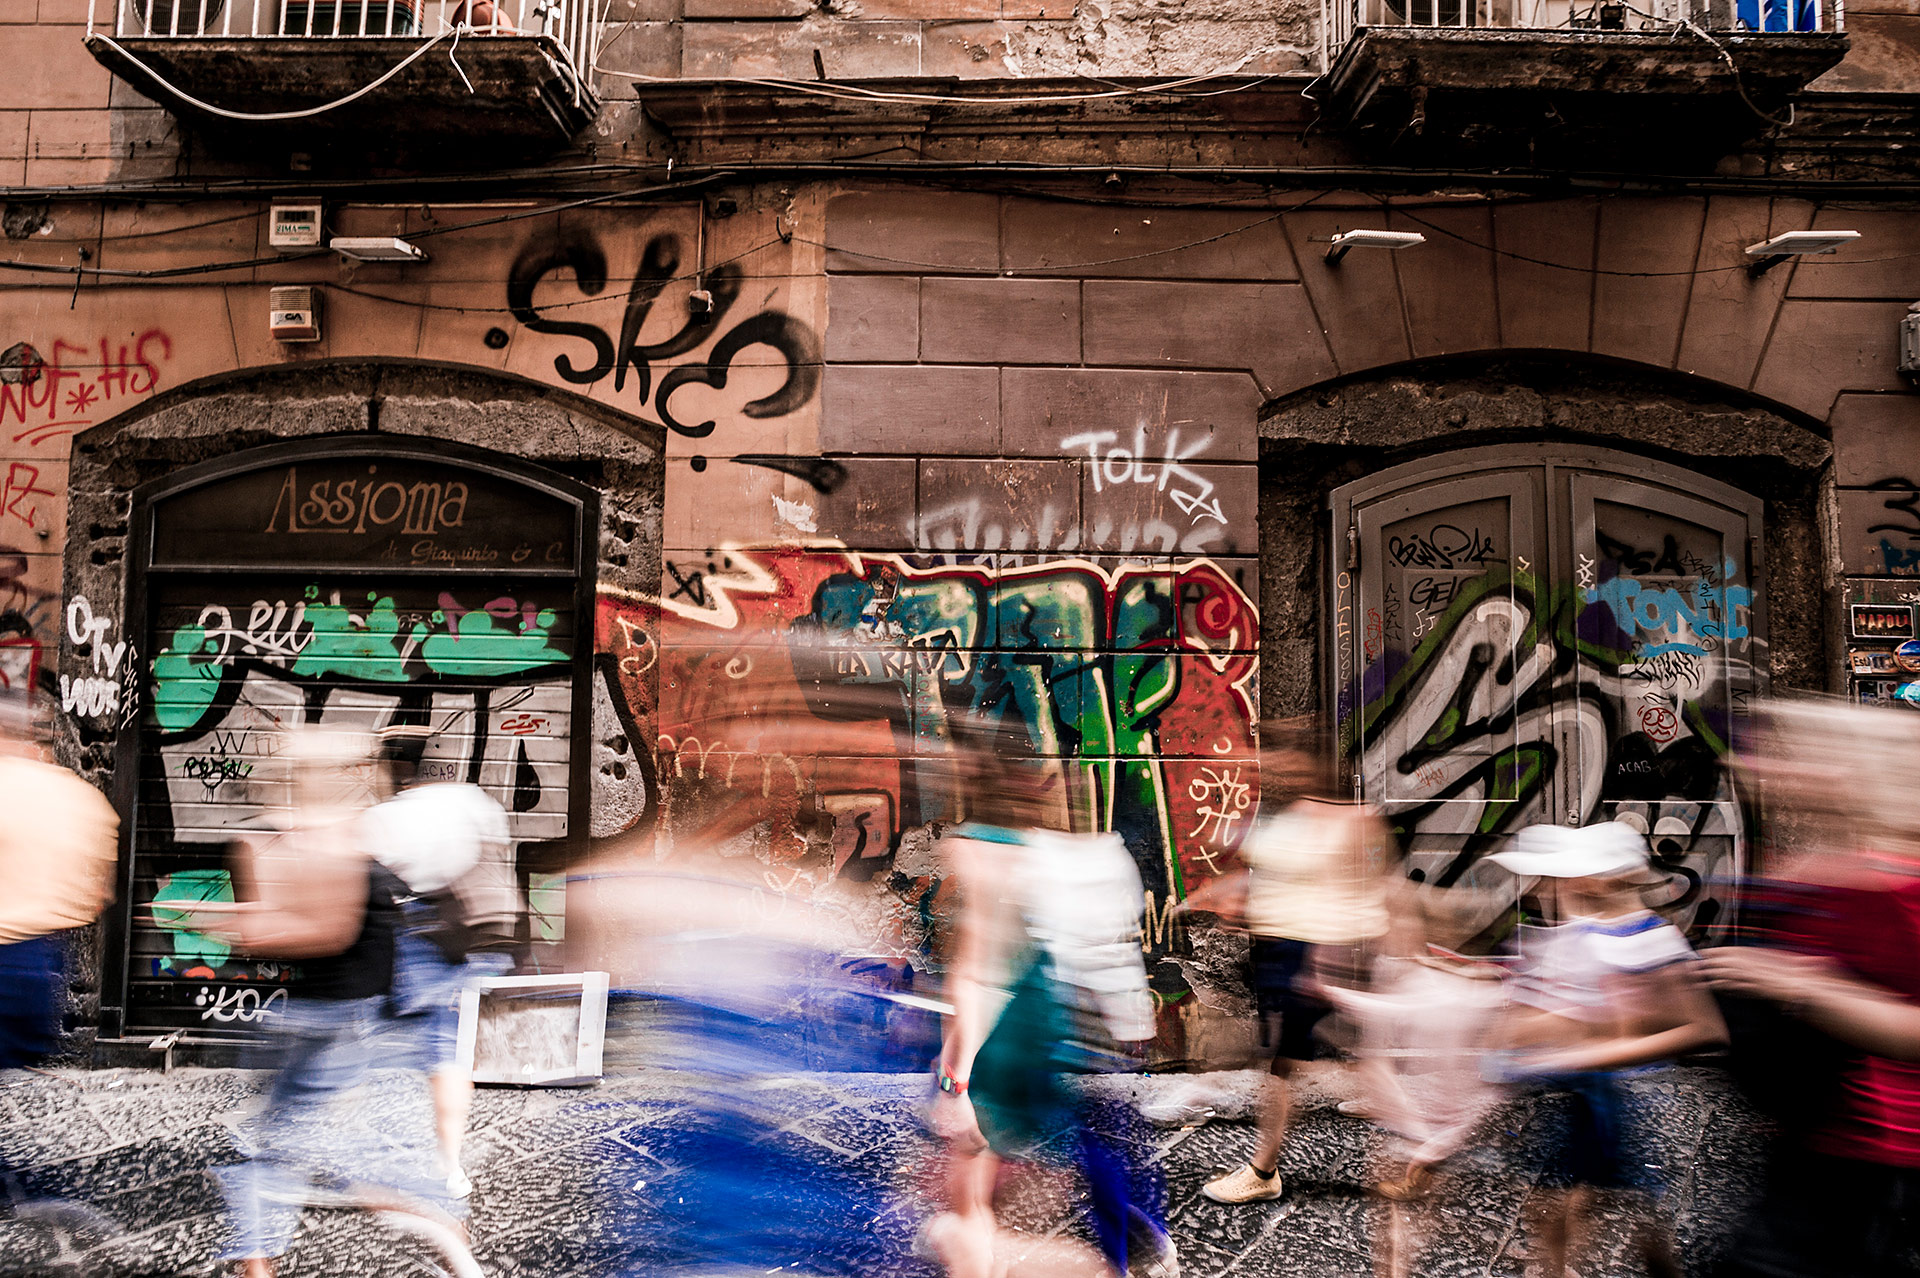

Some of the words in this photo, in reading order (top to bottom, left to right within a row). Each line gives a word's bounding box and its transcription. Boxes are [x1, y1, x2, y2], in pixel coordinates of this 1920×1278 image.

[264, 464, 469, 535] Assioma
[410, 540, 499, 567] Giaquinto
[1858, 613, 1908, 631] NAPOLI
